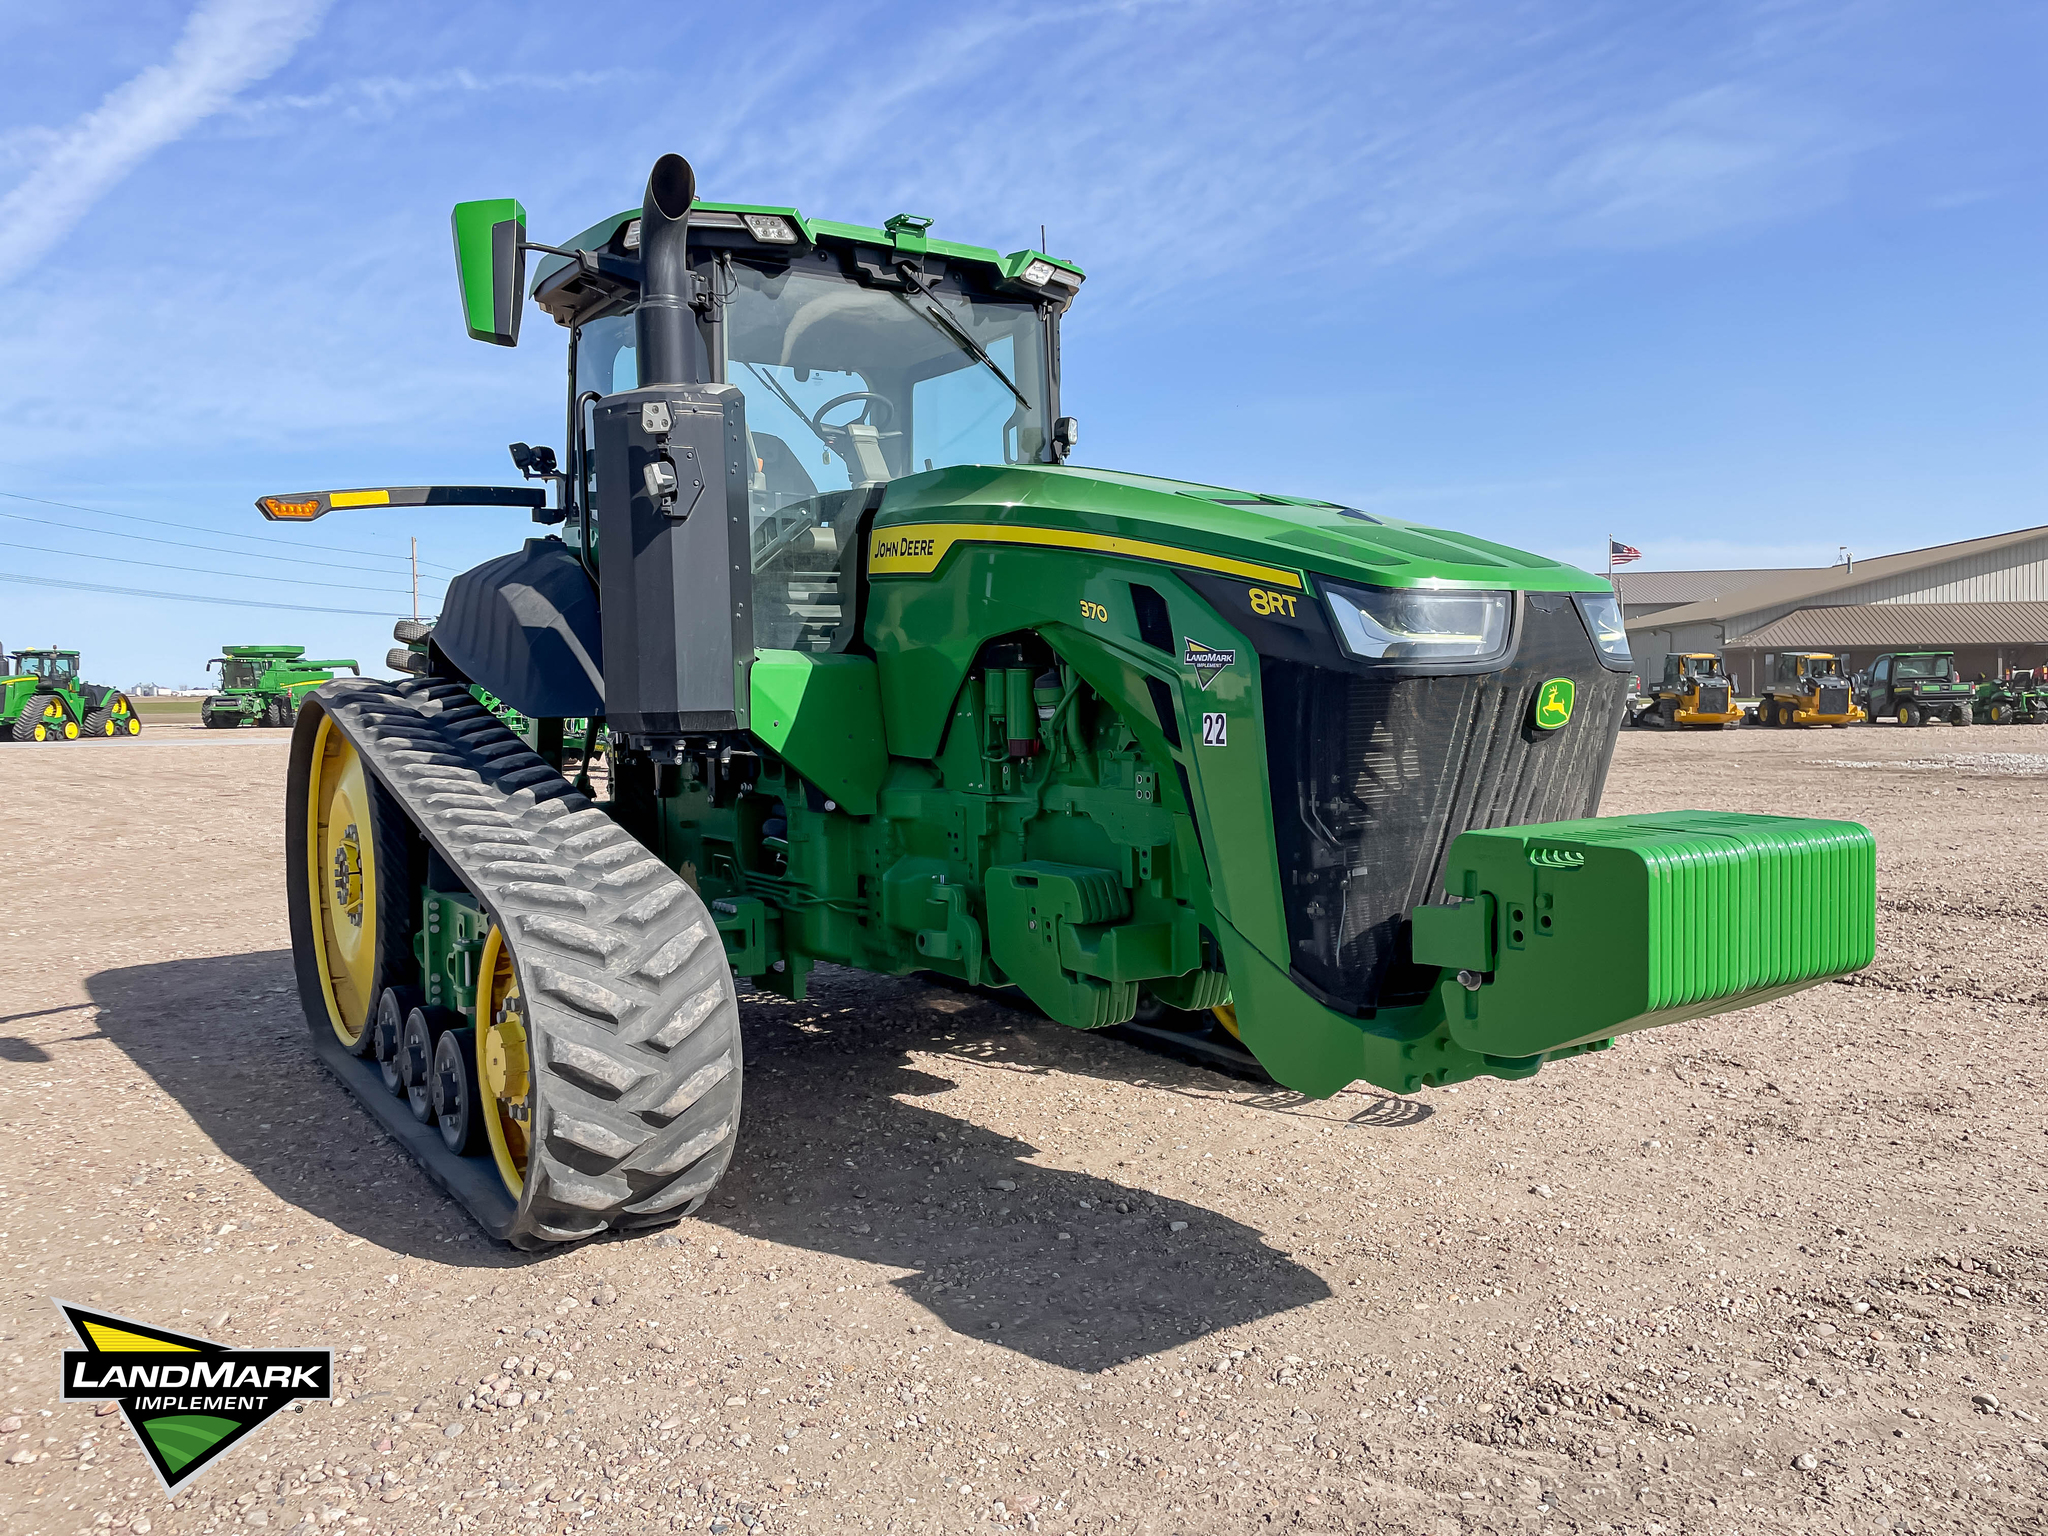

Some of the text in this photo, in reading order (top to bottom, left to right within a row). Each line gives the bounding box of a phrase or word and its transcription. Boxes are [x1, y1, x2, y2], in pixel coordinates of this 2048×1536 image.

[874, 537, 935, 558] JOHN DEERE
[1079, 599, 1108, 623] 370
[1248, 587, 1297, 618] 8RT
[1186, 653, 1233, 662] LANDMARK
[1204, 714, 1225, 744] 22
